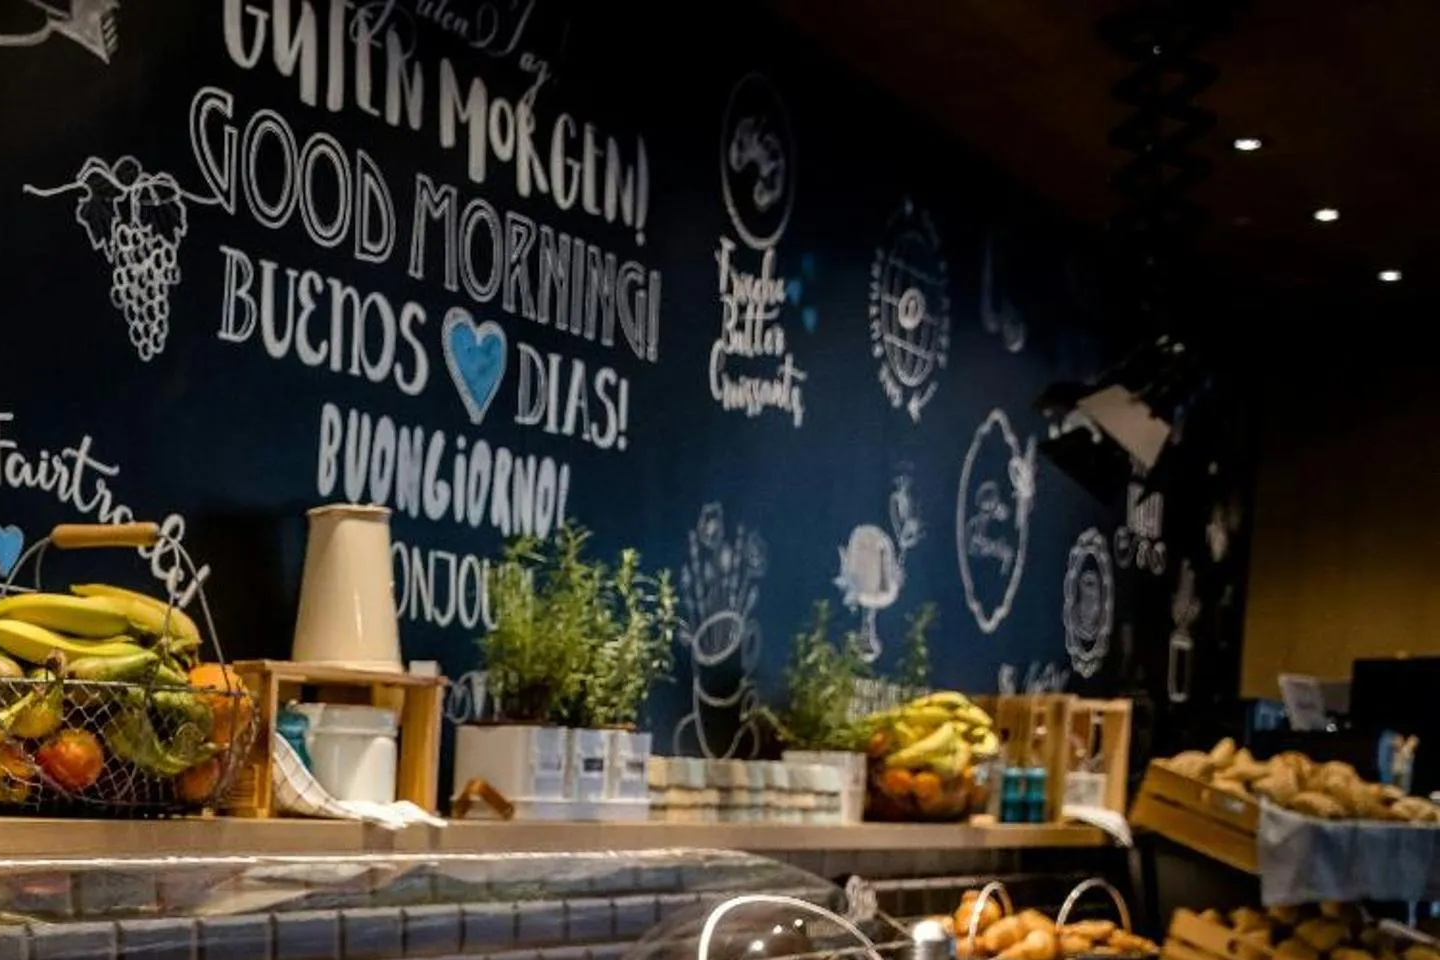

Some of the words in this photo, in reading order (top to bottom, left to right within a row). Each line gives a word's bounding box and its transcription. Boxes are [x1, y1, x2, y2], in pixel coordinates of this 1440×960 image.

[189, 86, 396, 264] GOOD
[439, 57, 650, 247] MORGEN!
[217, 244, 430, 396] BUENOS
[514, 342, 629, 452] DIAS!
